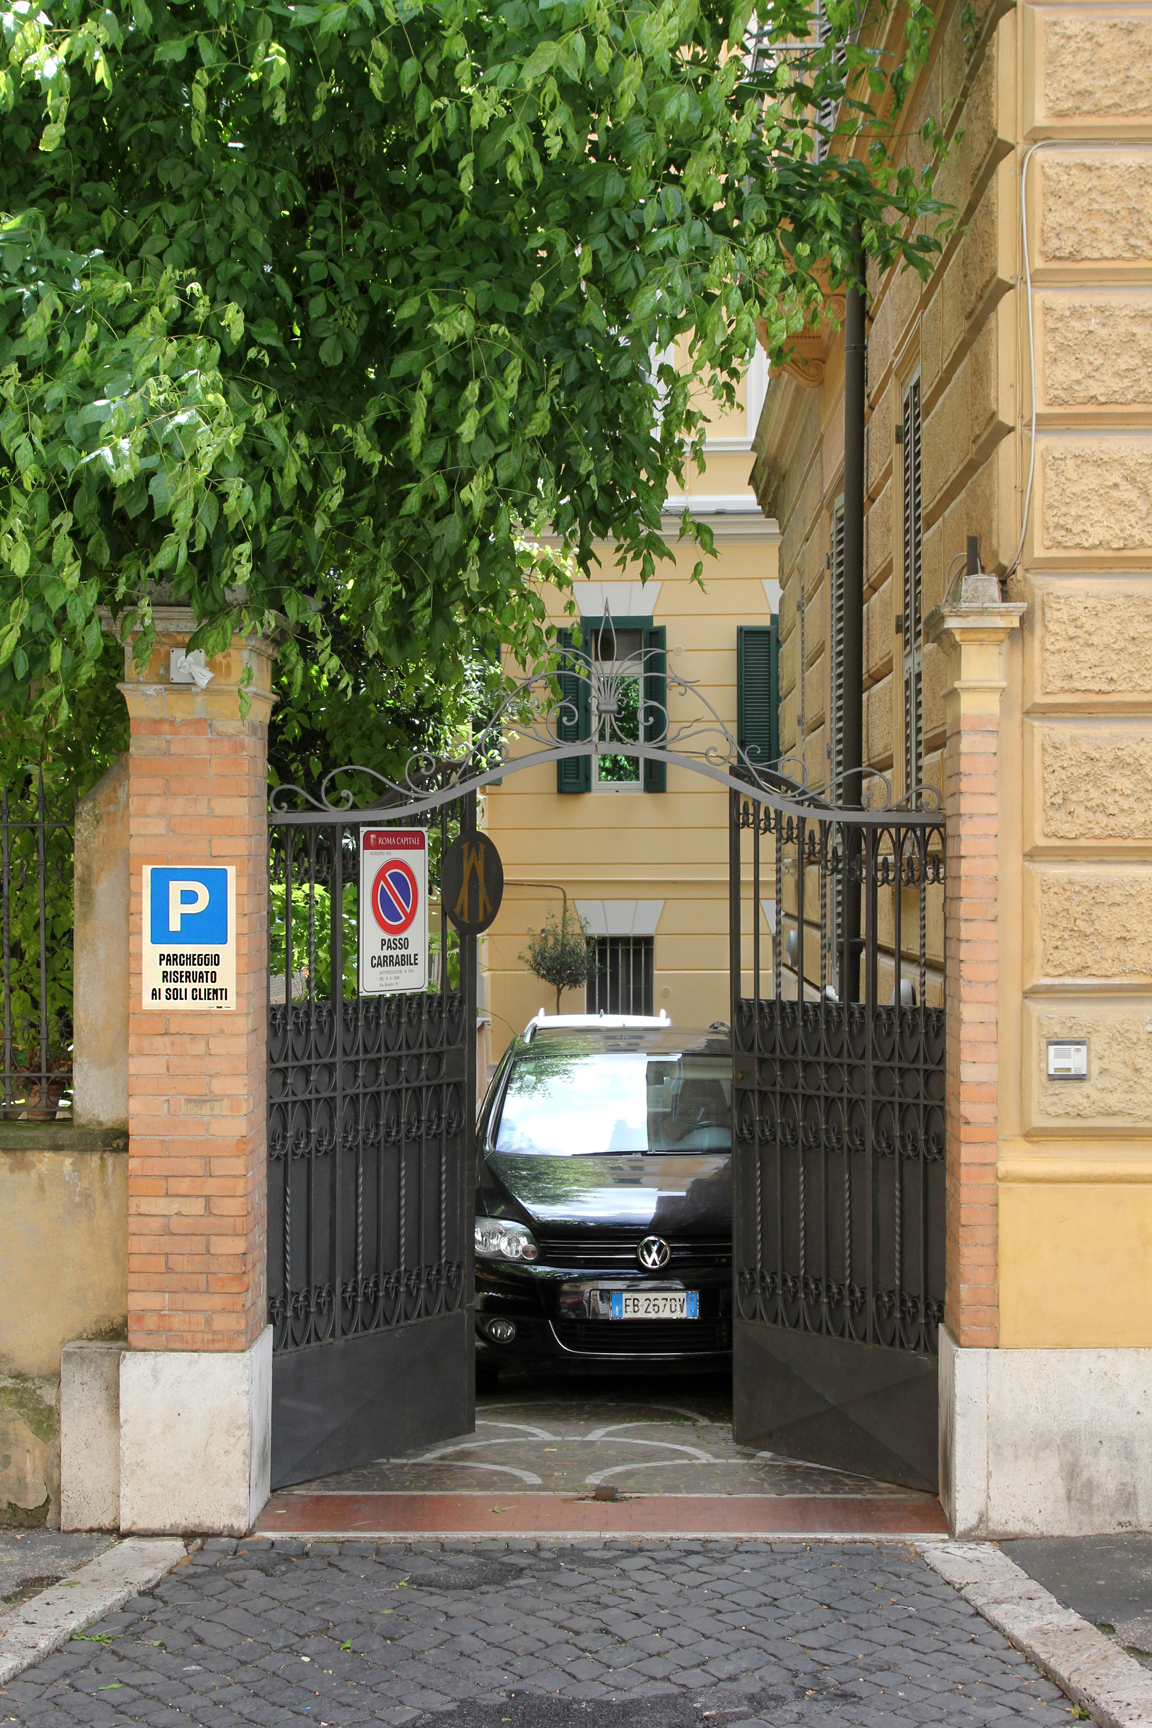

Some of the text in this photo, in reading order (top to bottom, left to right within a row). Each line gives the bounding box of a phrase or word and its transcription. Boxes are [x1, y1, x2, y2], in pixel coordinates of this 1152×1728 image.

[378, 837, 420, 845] ROMA CAPITALE
[168, 880, 210, 932] P
[380, 937, 409, 951] PASSO
[158, 953, 221, 966] PARCHEGGIO
[370, 953, 419, 968] CARRABILE
[161, 970, 217, 983] RISERVATO
[151, 987, 228, 1001] AI SOLI CLIENTI
